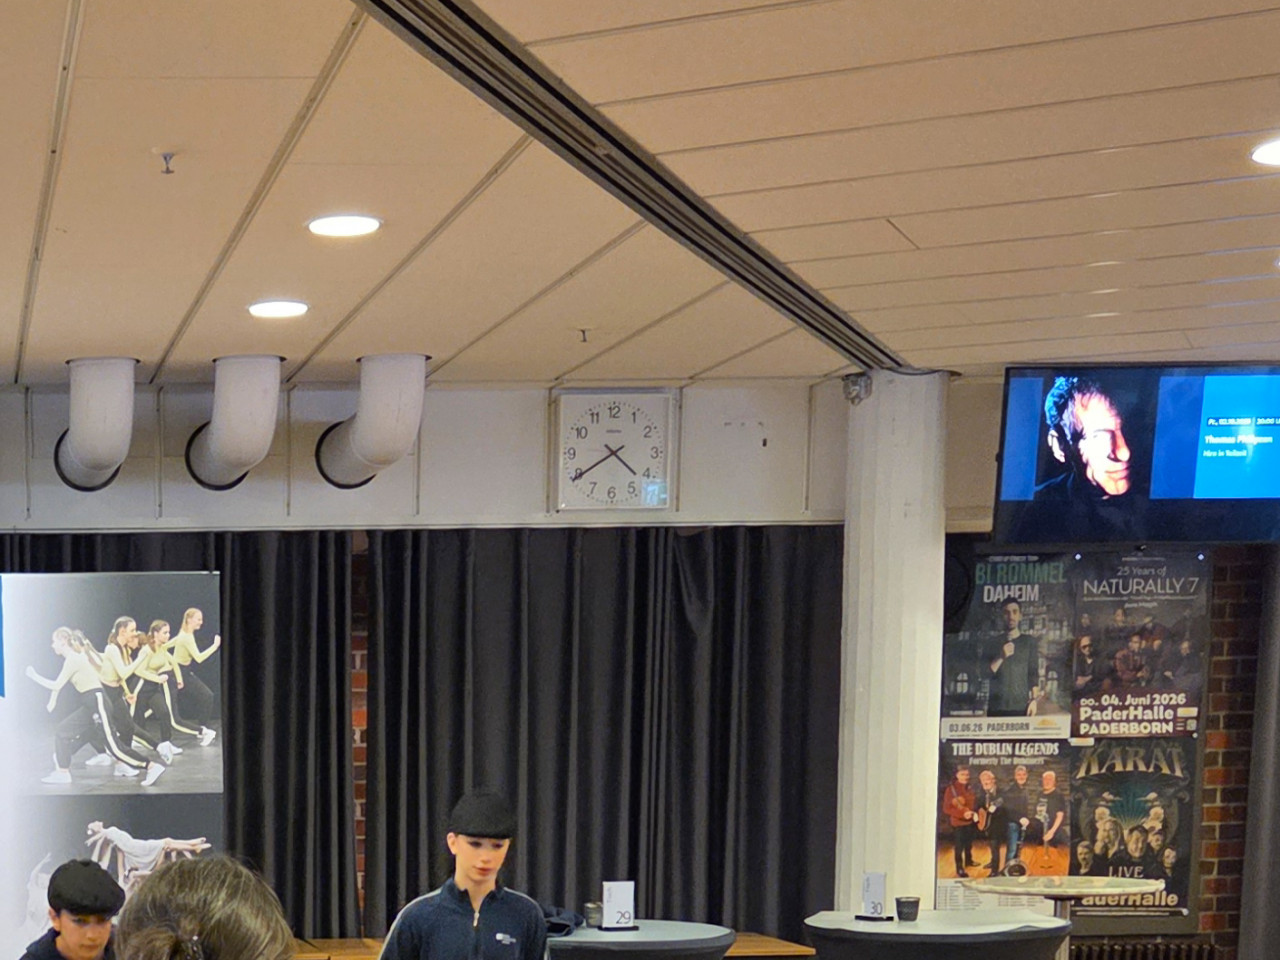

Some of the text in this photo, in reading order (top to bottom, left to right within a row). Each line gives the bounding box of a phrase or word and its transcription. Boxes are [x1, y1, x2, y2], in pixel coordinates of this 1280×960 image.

[590, 412, 600, 424] 11
[608, 405, 621, 418] 12
[576, 426, 588, 439] 10
[643, 425, 652, 438] 2
[567, 447, 576, 460] 9
[650, 446, 659, 459] 3
[575, 467, 583, 480] 8
[642, 467, 651, 479] 4
[589, 481, 598, 494] 7
[607, 486, 616, 499] 6
[627, 481, 636, 494] 5
[976, 562, 1067, 585] BI ROMMEL
[1117, 565, 1167, 577] 25 Years of
[1083, 577, 1200, 595] NATURALLY 7
[1101, 694, 1123, 706] 04.
[1125, 694, 1151, 706] Juni
[1152, 693, 1187, 705] 2026
[1080, 705, 1175, 721] PaderHalle
[987, 722, 1030, 732] PADERBORN
[1080, 721, 1174, 735] PADERBORN
[952, 743, 973, 756] THE
[975, 743, 1013, 755] DUBLIN
[1015, 742, 1060, 757] LEGENDS
[1075, 742, 1185, 779] KARAT
[1109, 866, 1144, 878] LIVE
[870, 900, 883, 916] 30
[616, 910, 632, 925] 29
